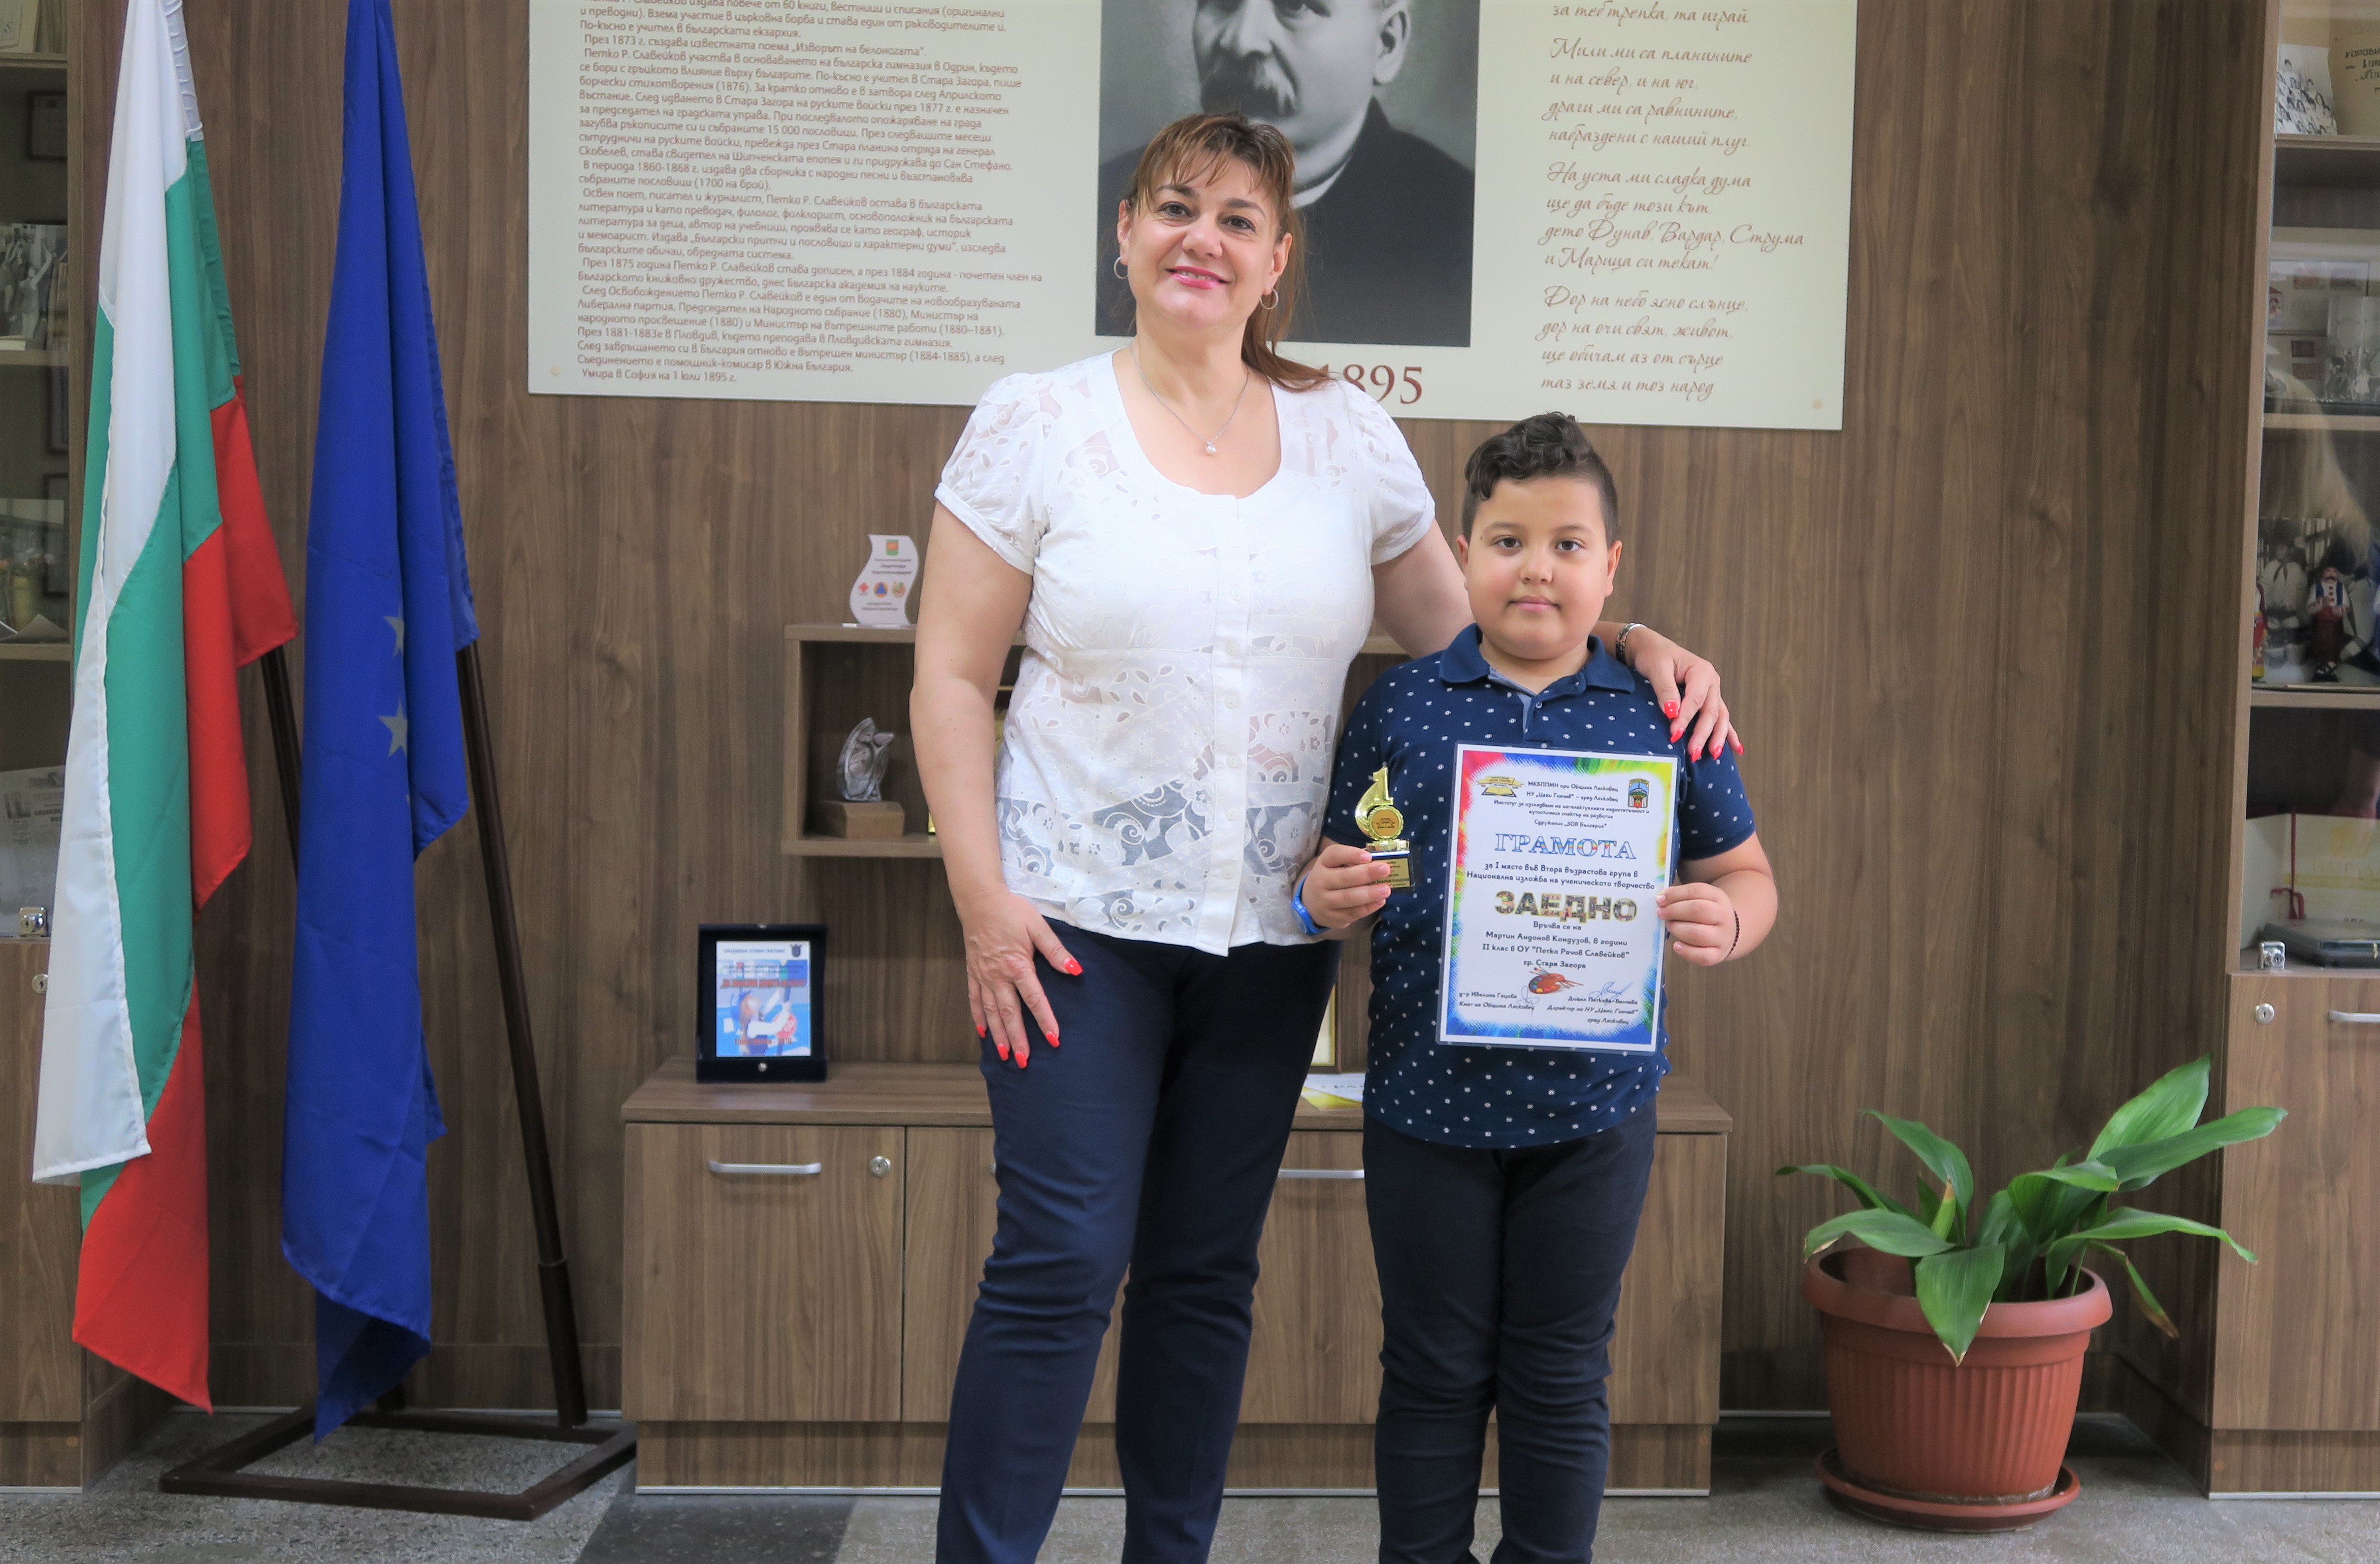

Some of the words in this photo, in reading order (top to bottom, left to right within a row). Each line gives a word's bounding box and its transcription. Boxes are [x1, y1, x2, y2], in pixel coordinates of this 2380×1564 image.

[580, 8, 586, 16] и
[647, 8, 678, 19] Взема
[680, 12, 724, 22] участие
[726, 10, 732, 21] в
[735, 12, 783, 24] църковна
[785, 13, 815, 26] борба
[826, 15, 858, 26] става
[860, 19, 885, 29] един
[887, 19, 903, 28] от
[905, 18, 996, 32] ръководителите
[1552, 5, 1570, 16] за
[1574, 1, 1607, 18] теб
[1673, 11, 1697, 21] та
[584, 33, 609, 47] През
[612, 35, 636, 46] 1873
[648, 36, 688, 49] създава
[690, 37, 756, 50] известната
[758, 42, 789, 51] поема
[791, 41, 843, 55] „Изворът
[1550, 37, 1607, 59] Мили
[1610, 47, 1636, 59] ми
[1639, 49, 1656, 59] са
[1660, 50, 1752, 63] планините
[1541, 100, 1593, 121] драги
[1596, 104, 1622, 115] ми
[1625, 105, 1642, 115] са
[1547, 161, 1577, 184] На
[1577, 172, 1621, 191] уста
[1624, 173, 1651, 184] ми
[1654, 167, 1710, 195] сладка
[1705, 176, 1751, 196] дума
[1537, 226, 1584, 246] дето
[1729, 223, 1804, 253] Струма
[1545, 255, 1555, 265] и
[1557, 246, 1632, 275] Марица
[1636, 258, 1654, 268] си
[1534, 321, 1567, 342] дор
[1571, 323, 1590, 334] на
[1594, 323, 1622, 335] очи
[577, 340, 601, 353] След
[604, 340, 676, 353] завръщането
[677, 345, 689, 353] си
[691, 343, 698, 353] в
[700, 343, 745, 356] България
[747, 345, 787, 356] отново
[798, 346, 853, 360] вътрешен
[855, 351, 907, 363] министър
[974, 354, 981, 363] а
[982, 354, 1005, 366] след
[577, 353, 654, 367] Съединението
[664, 357, 763, 372] помощник-комисар
[765, 359, 772, 370] в
[774, 360, 803, 371] Южна
[582, 368, 613, 380] Умира
[616, 368, 622, 378] в
[624, 369, 656, 381] София
[673, 371, 677, 380] 1
[681, 370, 701, 381] юли
[704, 371, 727, 382] 1895
[1541, 378, 1572, 389] таз
[1578, 379, 1616, 390] земя
[1621, 381, 1632, 391] и
[1635, 381, 1665, 393] тоз
[1494, 833, 1637, 860] ГРАМОТА
[1466, 870, 1514, 881] Национална
[1515, 875, 1547, 884] изложба
[1613, 880, 1655, 890] творчество
[1524, 863, 1539, 871] във
[1540, 864, 1562, 874] Втора
[1564, 866, 1607, 876] възрастова
[1609, 871, 1632, 879] група
[1495, 890, 1637, 923] ЗАЕДНО
[1533, 921, 1560, 930] Връчва
[1485, 931, 1515, 940] Мартин
[1517, 933, 1550, 942] Андонов
[1552, 935, 1591, 945] Кондузов,
[1560, 948, 1583, 956] Рачов
[1536, 959, 1558, 968] Стара
[1559, 960, 1586, 970] Загора
